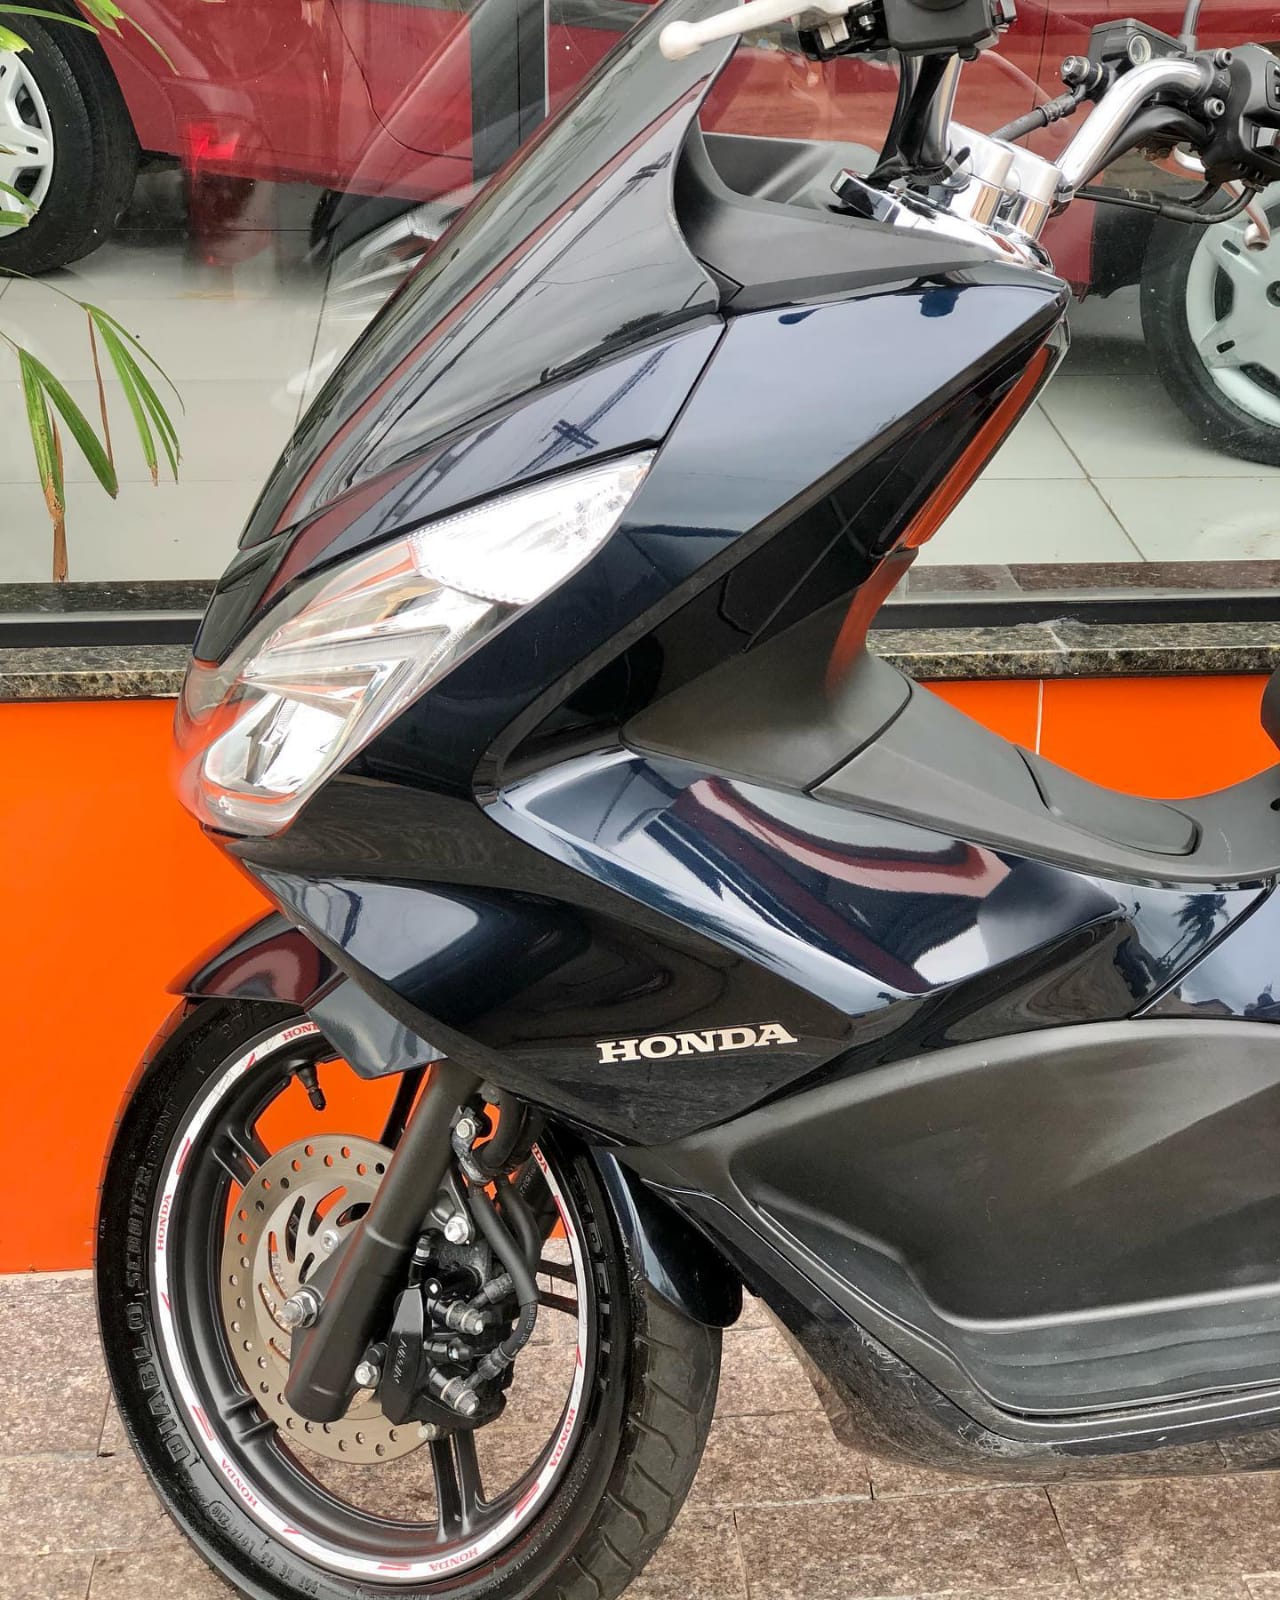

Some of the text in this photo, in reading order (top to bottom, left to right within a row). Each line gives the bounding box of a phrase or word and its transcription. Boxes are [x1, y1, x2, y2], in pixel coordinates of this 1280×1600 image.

[596, 1024, 798, 1064] HONDA
[157, 1194, 171, 1251] HONDA
[126, 1165, 191, 1463] DIABLO SCOOTER
[550, 1408, 576, 1467] HONDA
[221, 1458, 257, 1507] HONDA
[429, 1547, 479, 1572] HONDA
